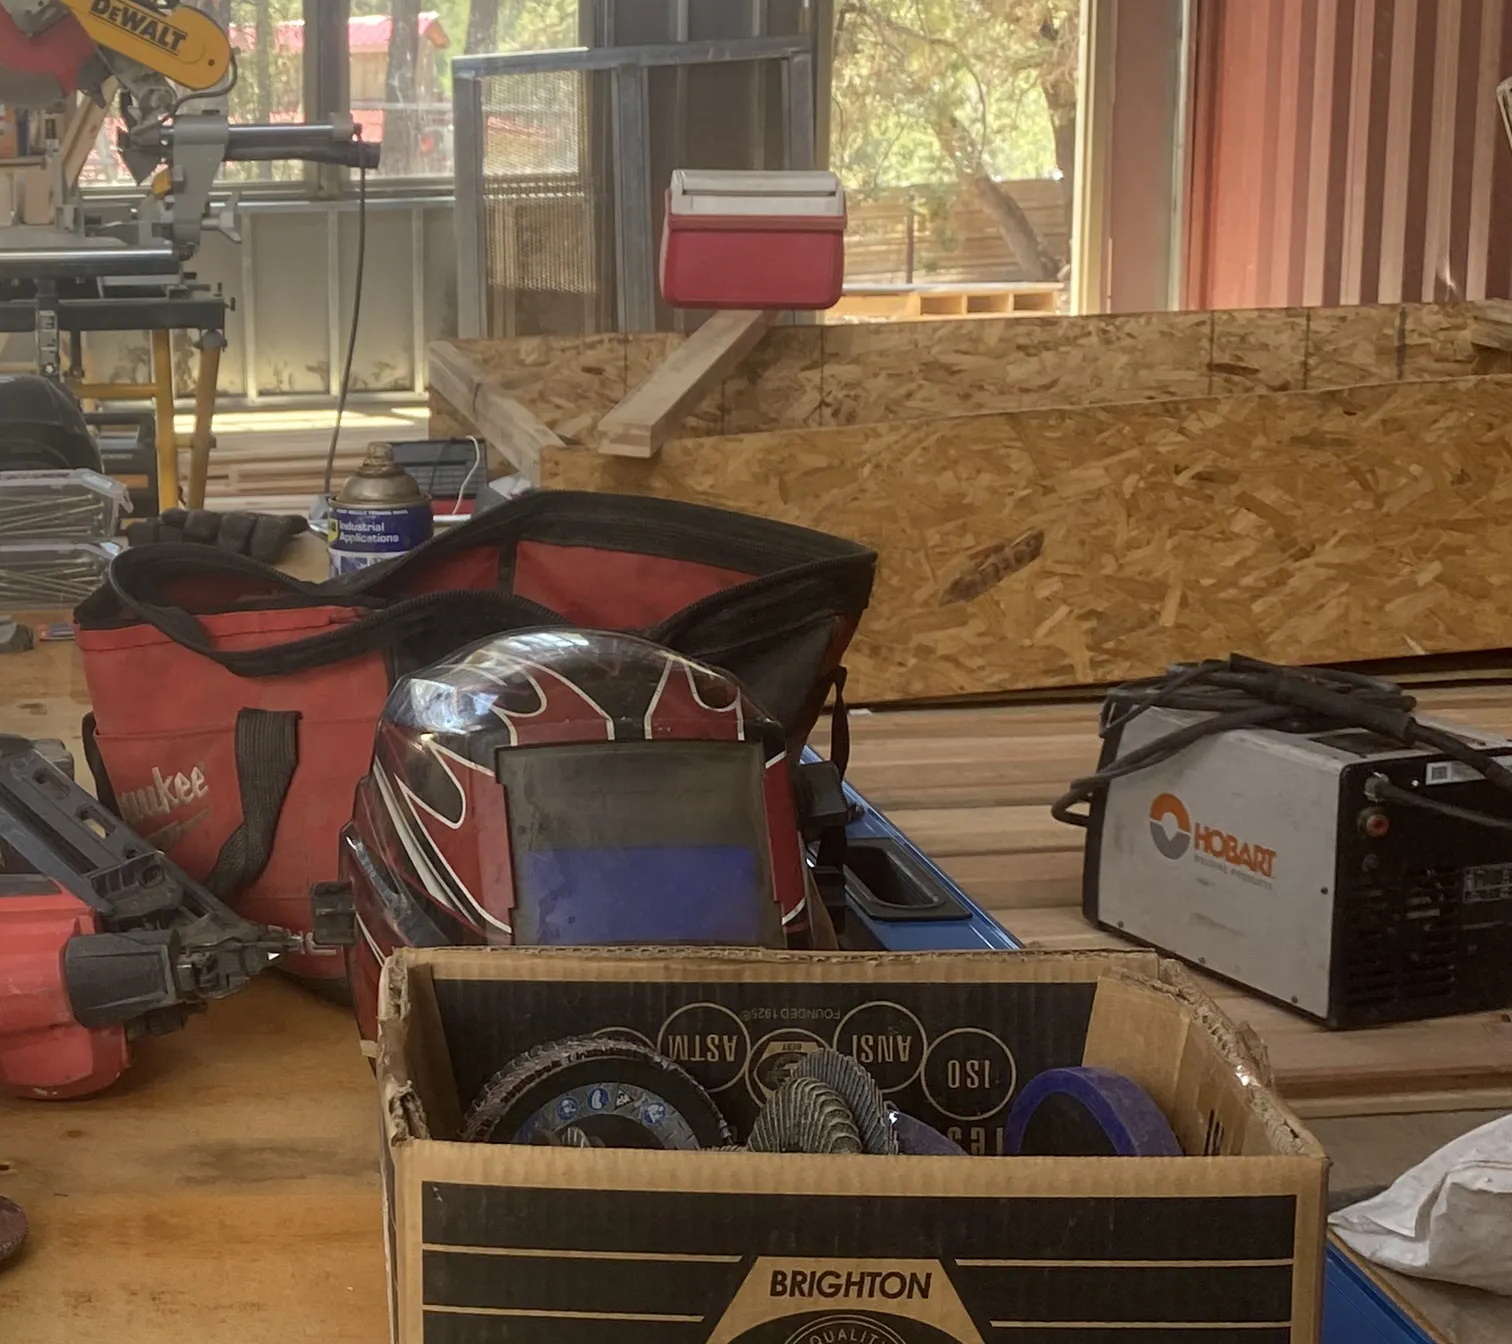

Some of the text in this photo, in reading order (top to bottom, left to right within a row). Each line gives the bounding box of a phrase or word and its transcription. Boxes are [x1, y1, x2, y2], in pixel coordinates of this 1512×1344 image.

[339, 523, 385, 532] Industrial
[339, 534, 399, 544] Applications
[1194, 822, 1276, 878] HOBART
[779, 1009, 840, 1020] FOUNDED
[668, 1034, 738, 1062] ASTM
[851, 1033, 912, 1061] ANSI
[947, 1059, 991, 1088] ISO
[770, 1270, 932, 1299] BRIGHTON
